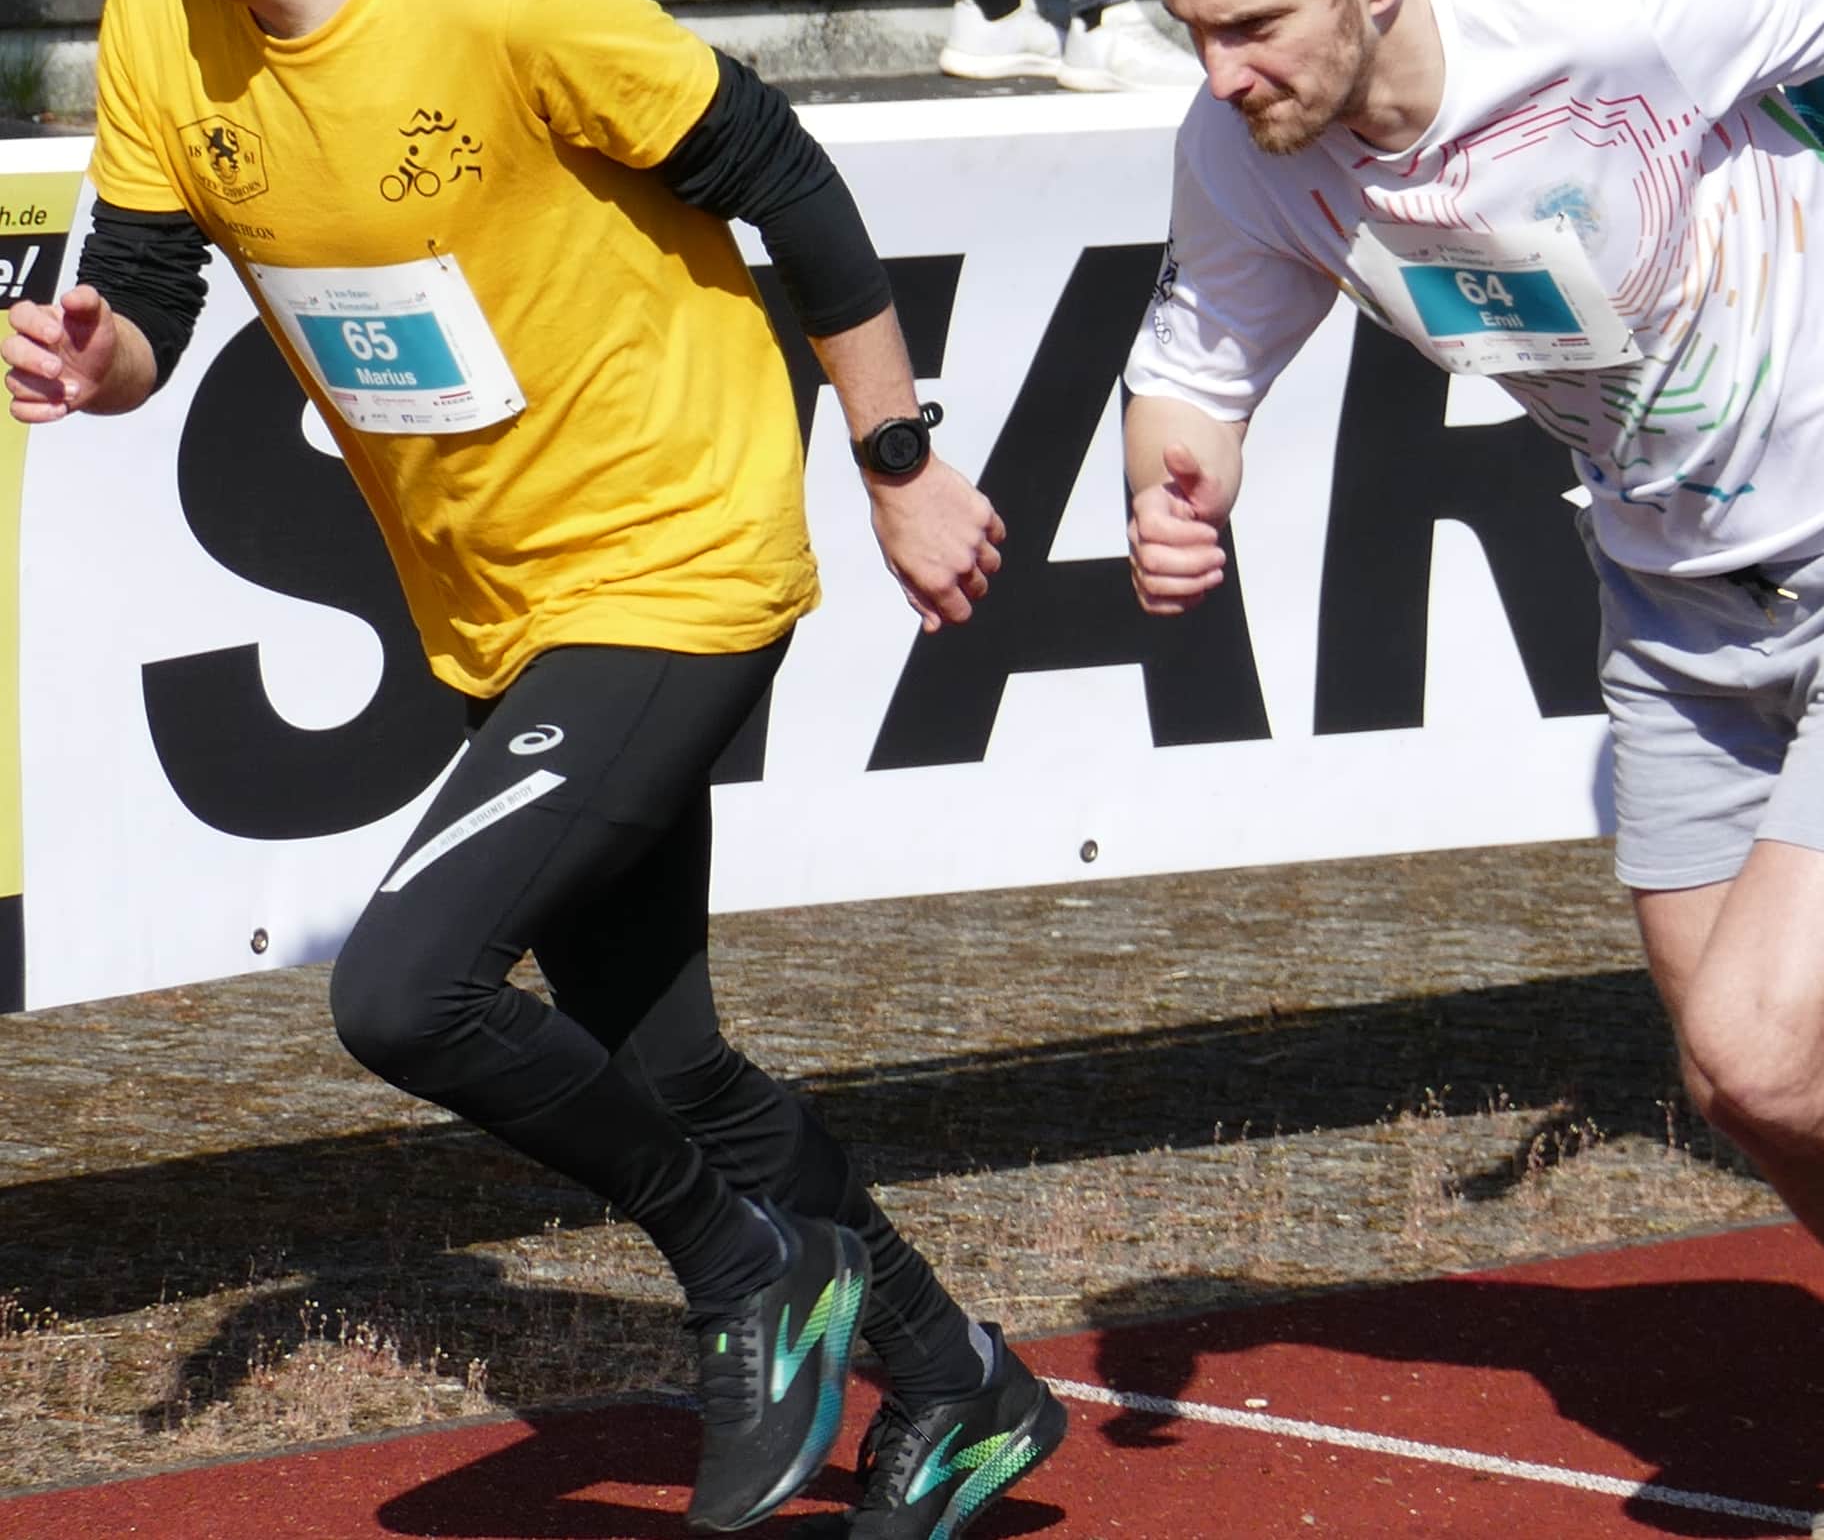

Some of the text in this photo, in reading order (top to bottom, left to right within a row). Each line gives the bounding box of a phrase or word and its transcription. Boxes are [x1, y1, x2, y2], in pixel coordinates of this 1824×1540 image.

[1455, 271, 1515, 308] 64
[1480, 310, 1525, 328] Emil
[342, 321, 399, 362] 65
[356, 367, 417, 387] Marius
